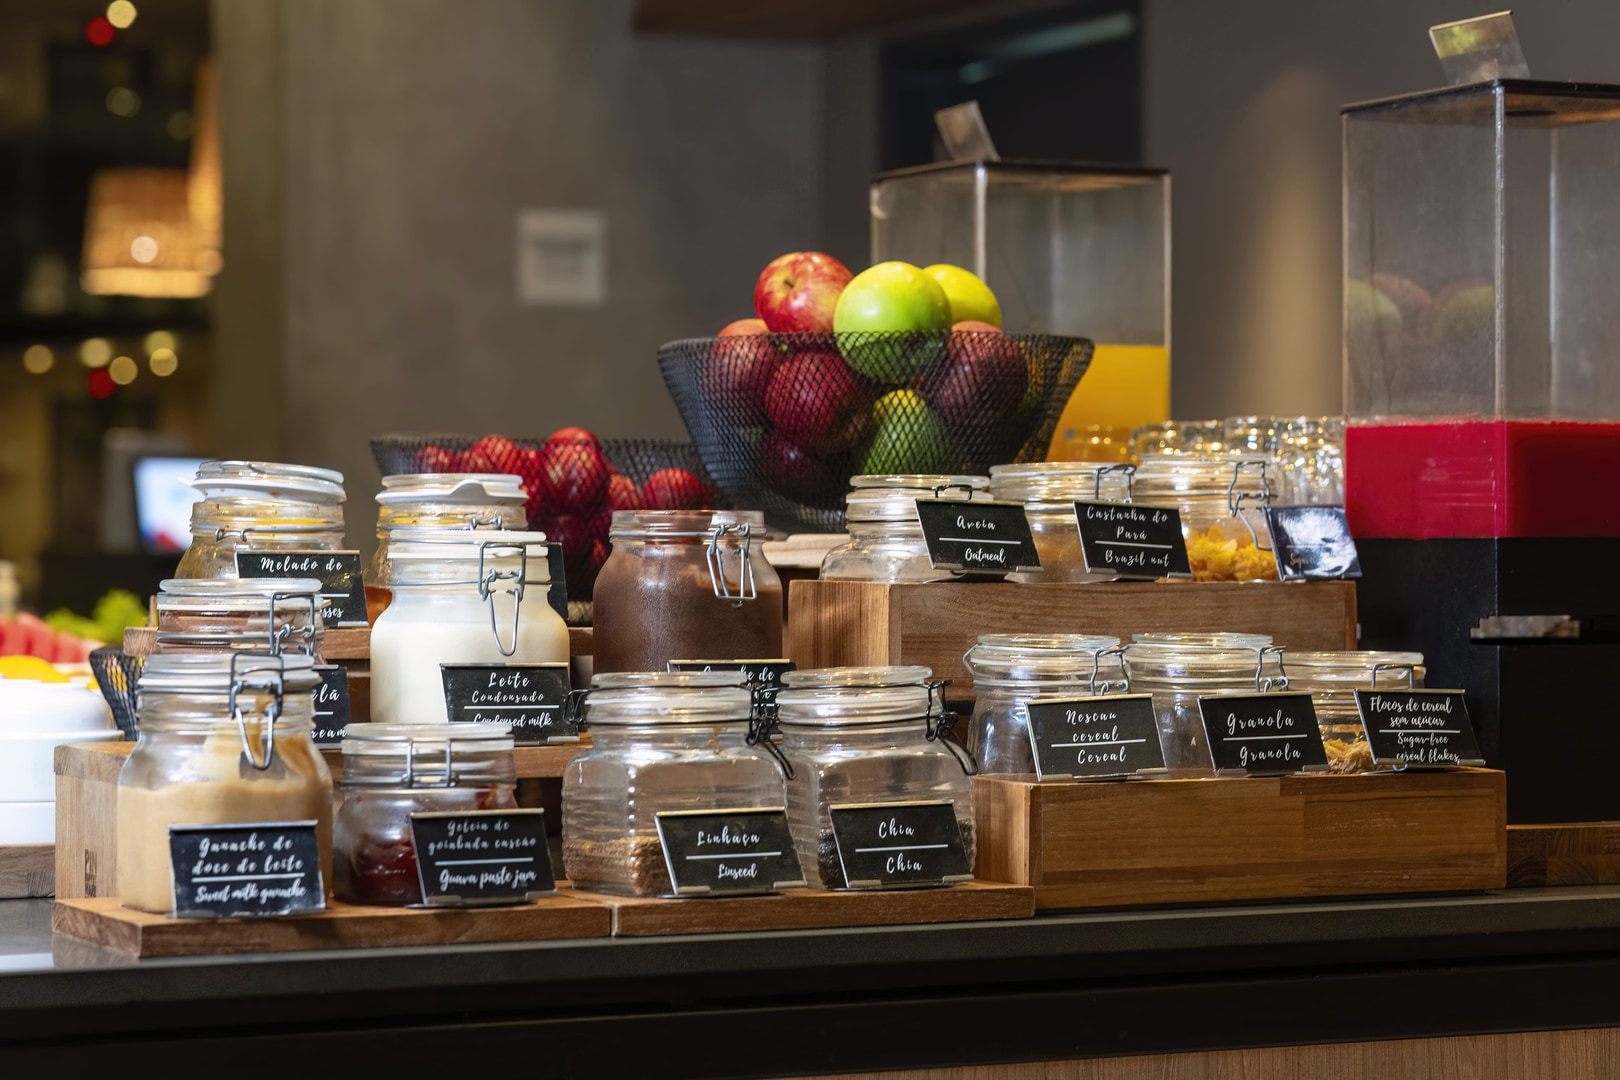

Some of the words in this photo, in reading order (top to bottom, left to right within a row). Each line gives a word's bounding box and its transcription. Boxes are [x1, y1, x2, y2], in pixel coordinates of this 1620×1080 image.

[956, 515, 996, 530] Aveia
[1086, 505, 1147, 521] Castanha
[1152, 510, 1168, 524] do
[1116, 526, 1147, 540] Pará
[260, 555, 319, 573] Melado
[325, 557, 343, 571] de
[964, 547, 1006, 563] Oatmeal
[1104, 549, 1146, 566] Brazil
[1150, 554, 1170, 567] nut
[488, 671, 530, 689] Leite
[758, 666, 775, 682] de
[471, 690, 544, 704] Condensado
[1370, 695, 1403, 713] Flocos
[1405, 697, 1420, 712] de
[1421, 696, 1453, 713] cereal
[528, 711, 553, 728] milk
[1065, 709, 1118, 725] Nescau
[1227, 709, 1295, 735] Granola
[1390, 715, 1409, 727] sem
[1410, 715, 1446, 728] açúcar
[311, 728, 348, 739] ream
[1072, 725, 1119, 742] cereal
[1397, 731, 1449, 748] Sugar-free
[1077, 745, 1127, 765] Cereal
[1239, 742, 1302, 767] Granola
[1396, 748, 1426, 763] cereal
[1428, 748, 1460, 763] flakes
[447, 819, 489, 837] Geleia
[494, 819, 510, 832] de
[696, 825, 761, 847] Linhaça
[878, 817, 915, 838] Chia
[199, 832, 267, 859] Ganache
[272, 835, 294, 851] de
[428, 835, 490, 856] goiabada
[191, 860, 231, 875] doce
[236, 858, 258, 873] de
[263, 854, 304, 873] leite
[717, 863, 758, 880] Linseed
[886, 852, 923, 874] Chia
[439, 868, 479, 892] Guava
[479, 866, 513, 890] paste
[511, 869, 537, 889] jam
[194, 884, 231, 903] Sweet
[231, 882, 260, 901] milk
[260, 878, 308, 905] ganache
